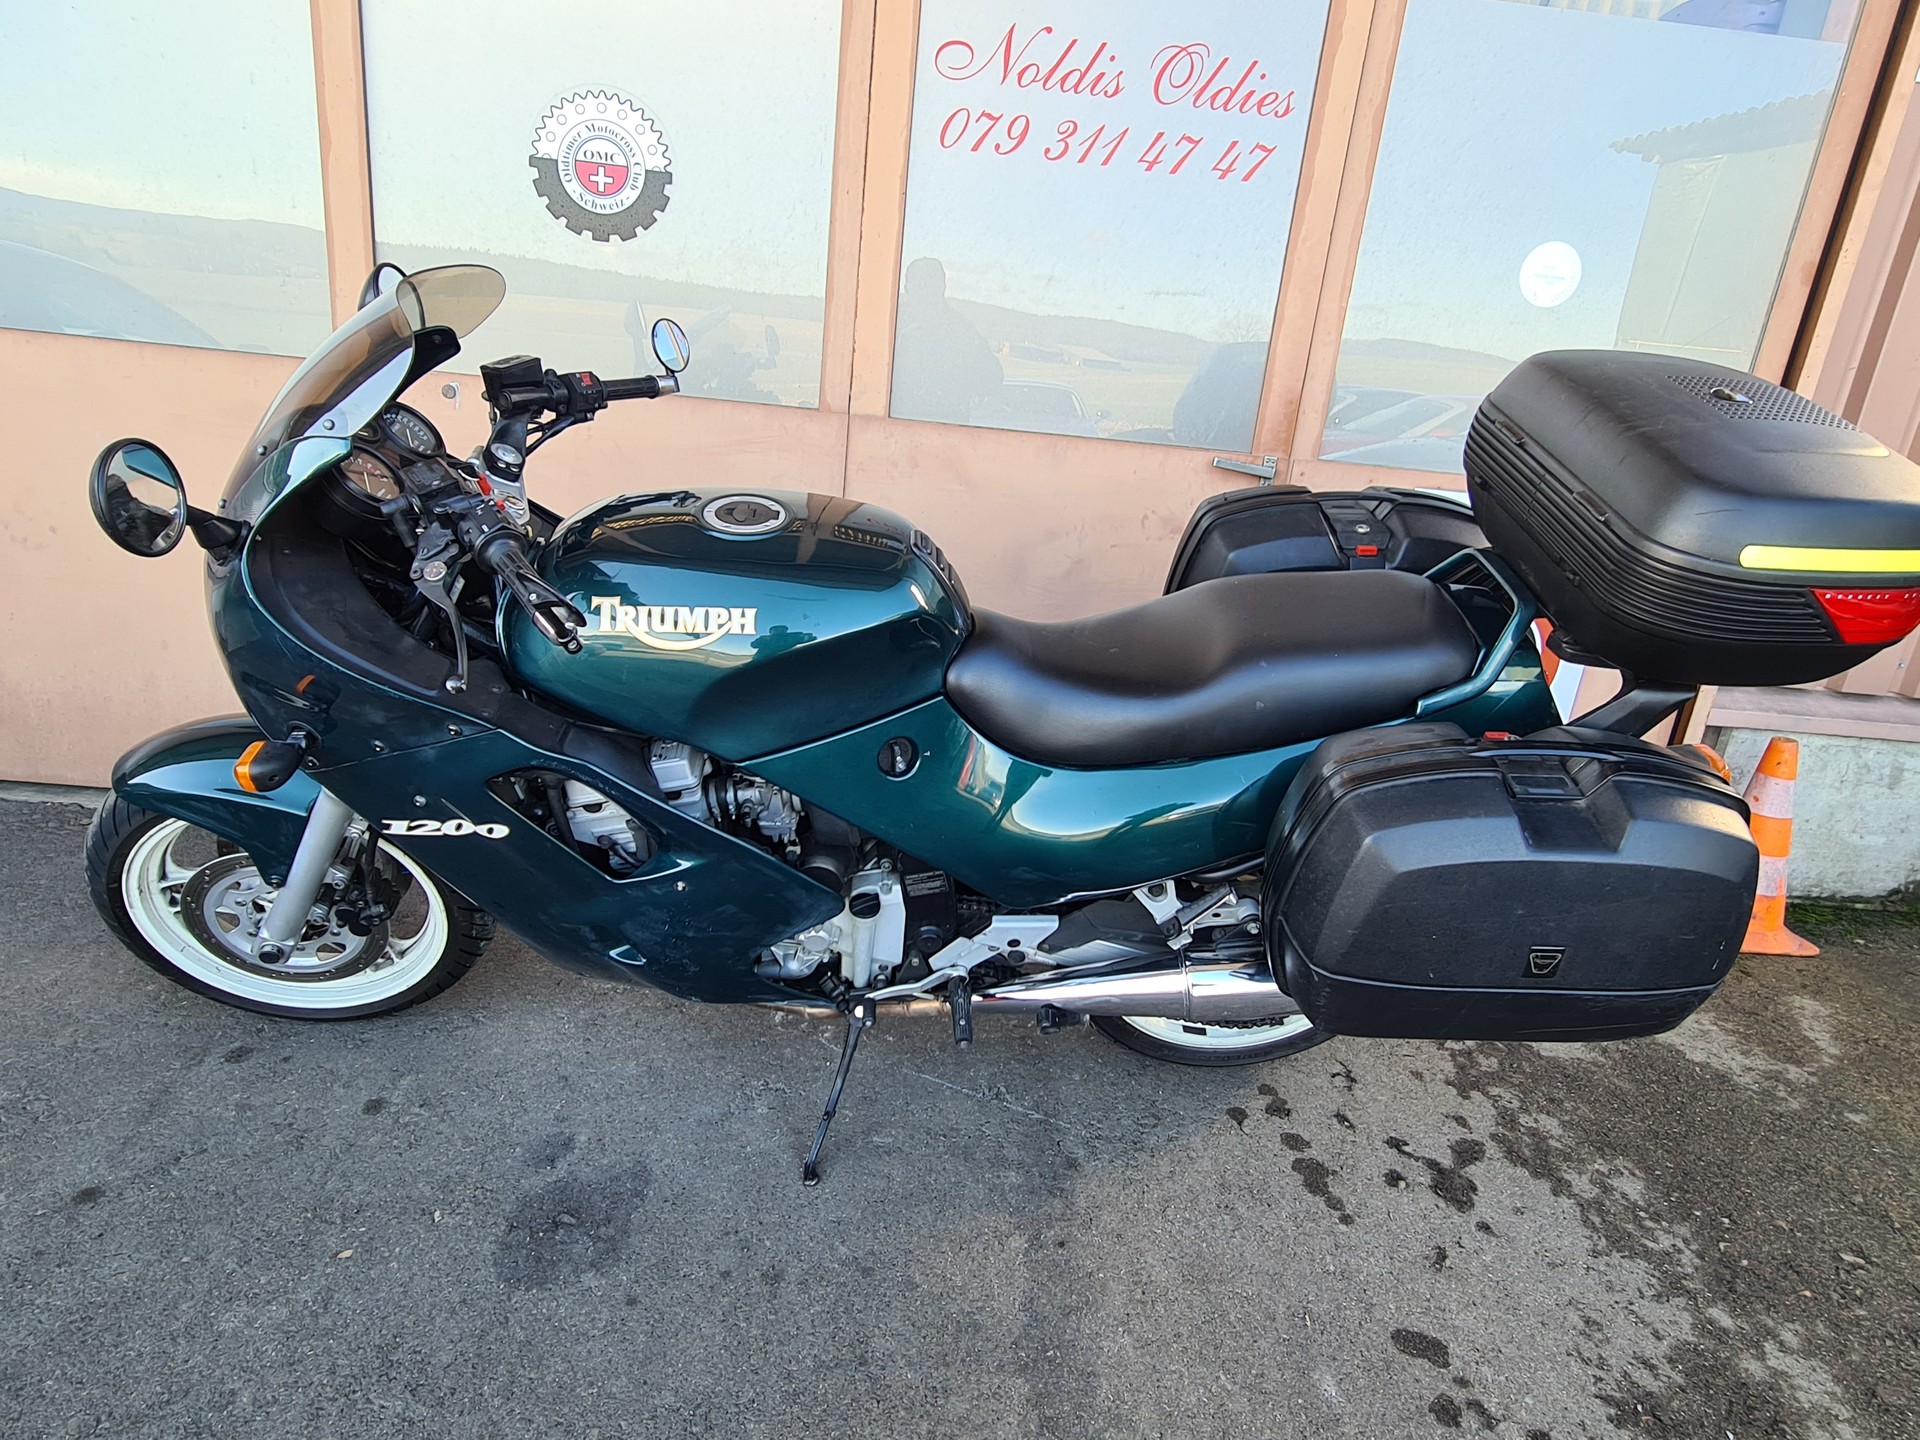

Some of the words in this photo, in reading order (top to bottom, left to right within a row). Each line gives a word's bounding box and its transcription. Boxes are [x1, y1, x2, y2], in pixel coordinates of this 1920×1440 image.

[934, 22, 1126, 98] Noldis
[1150, 42, 1295, 119] Oldies
[560, 130, 583, 183] Oldtimer
[584, 122, 637, 159] Motocross
[629, 161, 643, 191] Club
[583, 149, 621, 164] OMC
[939, 107, 1031, 155] 079
[1044, 119, 1130, 166] 311
[1137, 131, 1204, 175] 47
[1211, 140, 1278, 182] 47
[576, 190, 626, 211] Schweiz
[590, 595, 758, 650] TRIUMPH
[381, 818, 511, 839] 1200
